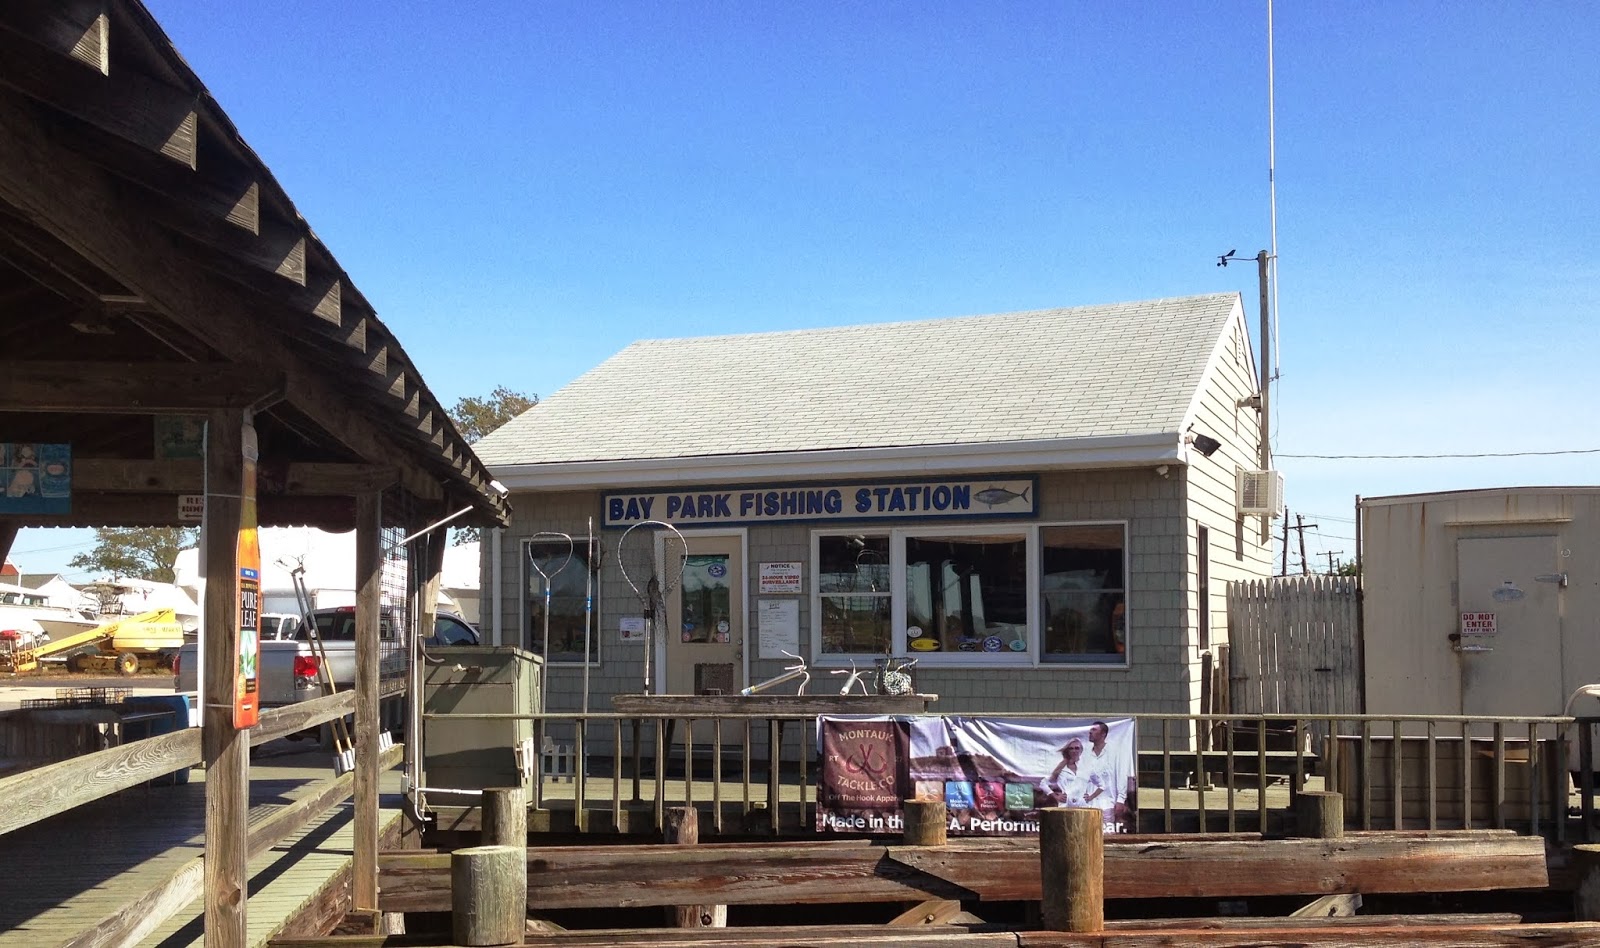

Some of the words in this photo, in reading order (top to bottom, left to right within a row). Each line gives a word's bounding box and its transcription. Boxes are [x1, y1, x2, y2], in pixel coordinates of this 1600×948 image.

[187, 497, 204, 505] RES
[609, 497, 654, 520] BAY
[666, 493, 732, 519] PARK
[740, 489, 842, 517] FISHING
[855, 485, 971, 513] STATION
[241, 591, 258, 610] PURE
[241, 610, 257, 628] LEAF
[838, 730, 894, 742] MONTAUK
[841, 794, 856, 802] The
[857, 795, 875, 803] Hook
[823, 814, 866, 829] Made
[869, 814, 884, 830] in
[887, 814, 903, 830] th
[970, 817, 1040, 832] Perform
[1103, 822, 1128, 834] ar.
